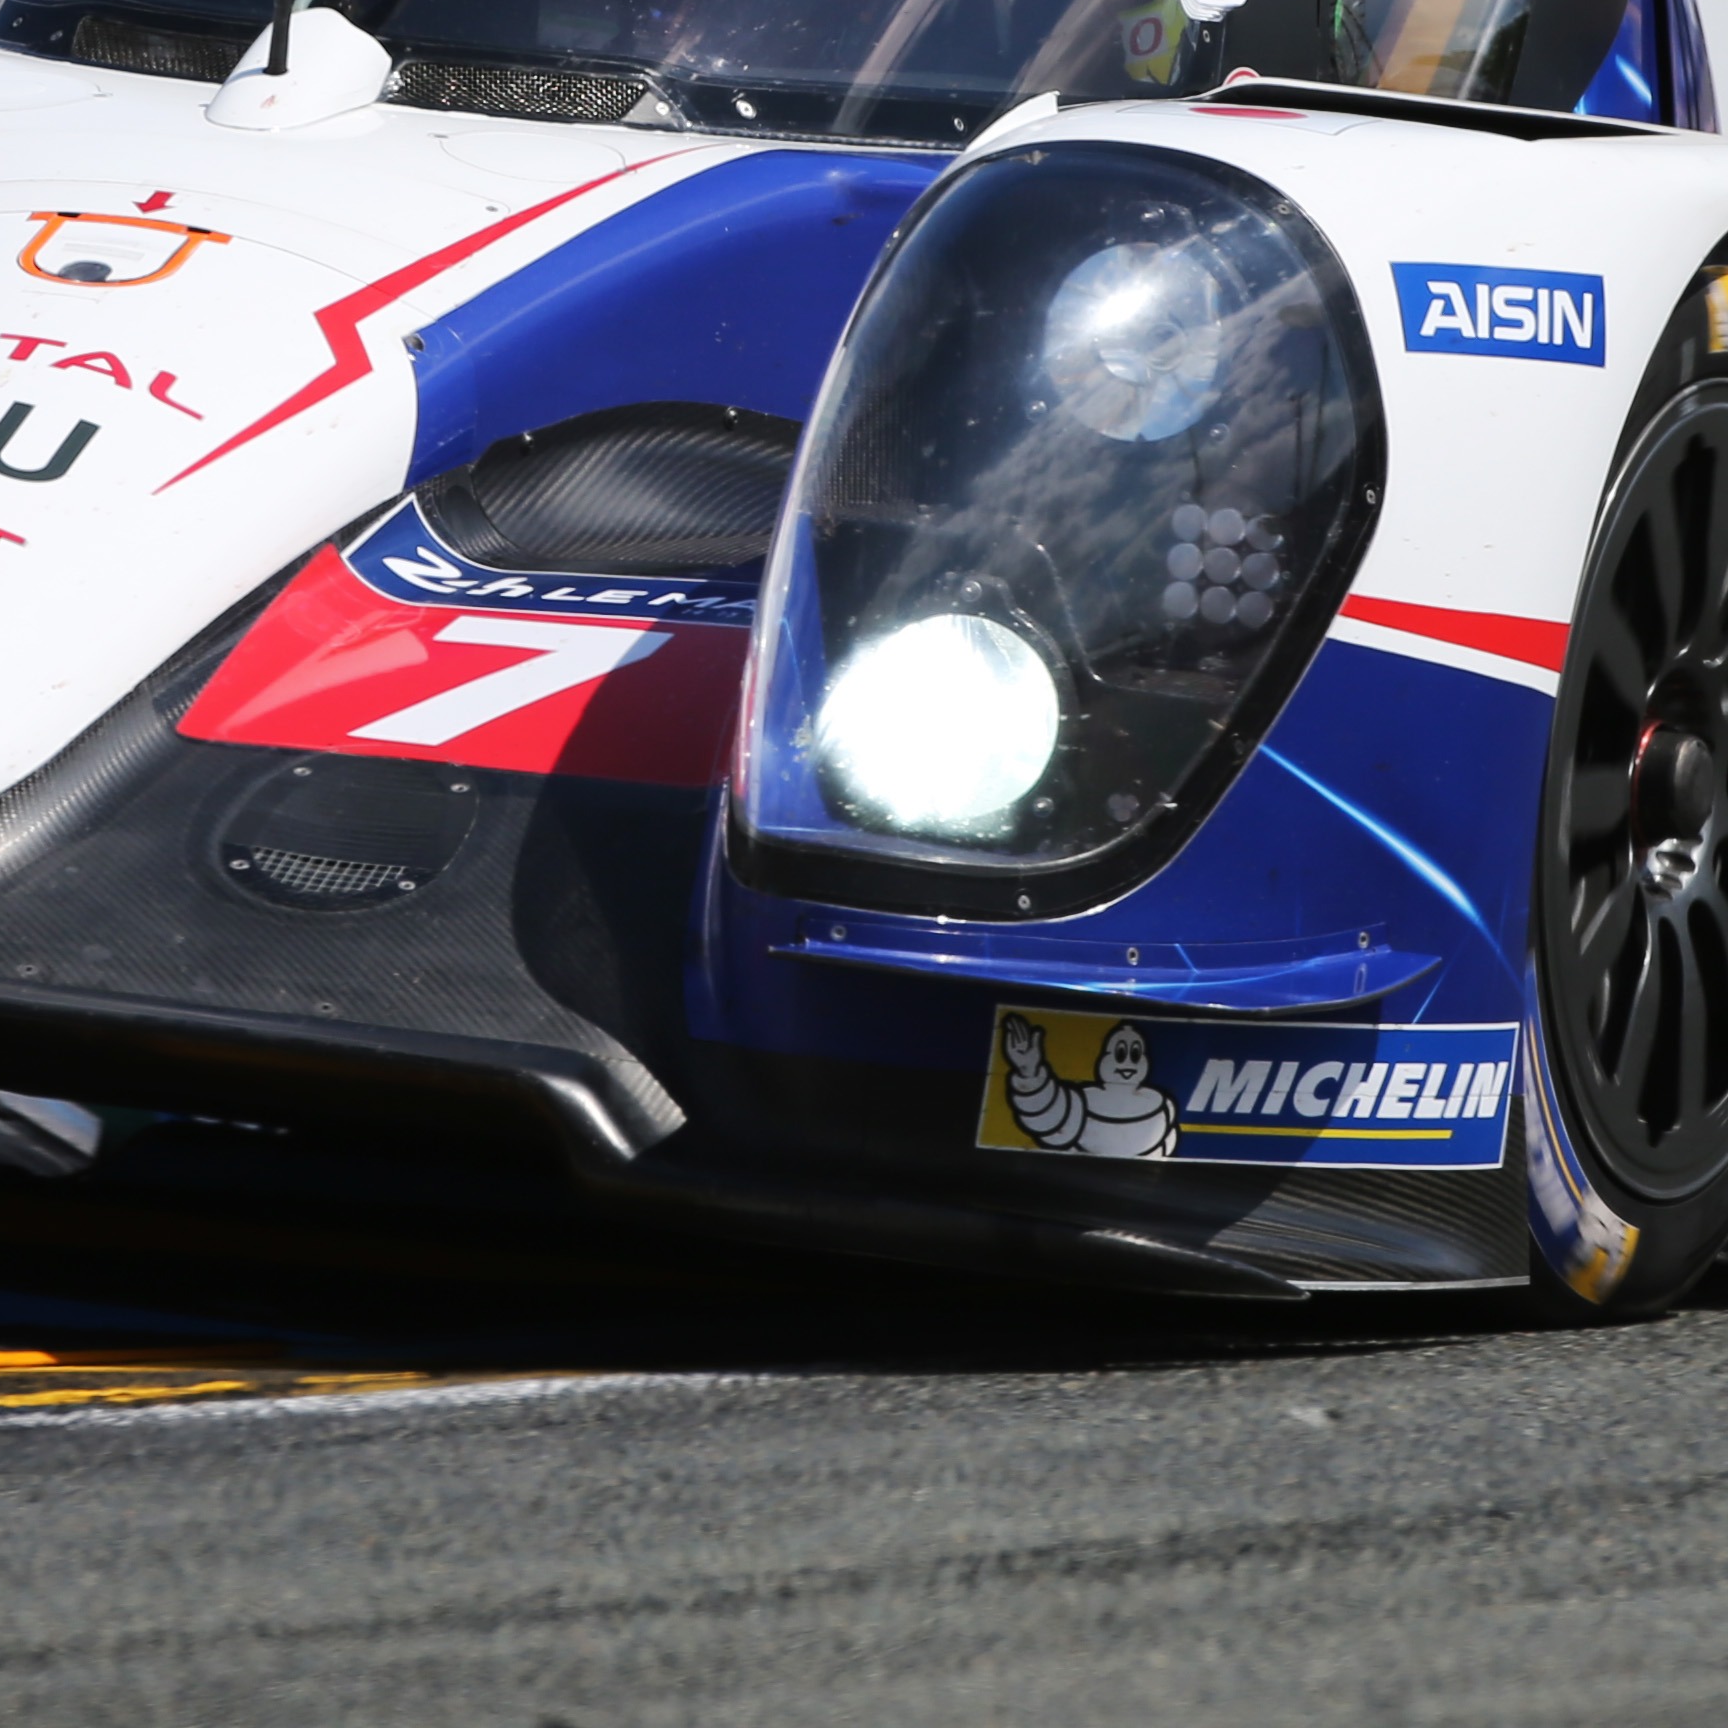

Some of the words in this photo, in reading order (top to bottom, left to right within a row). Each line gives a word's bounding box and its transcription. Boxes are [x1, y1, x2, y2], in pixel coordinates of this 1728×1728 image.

[1420, 281, 1593, 349] AISIN
[540, 586, 649, 606] LE
[347, 616, 674, 746] 7
[1186, 1059, 1508, 1119] MICHELIN
